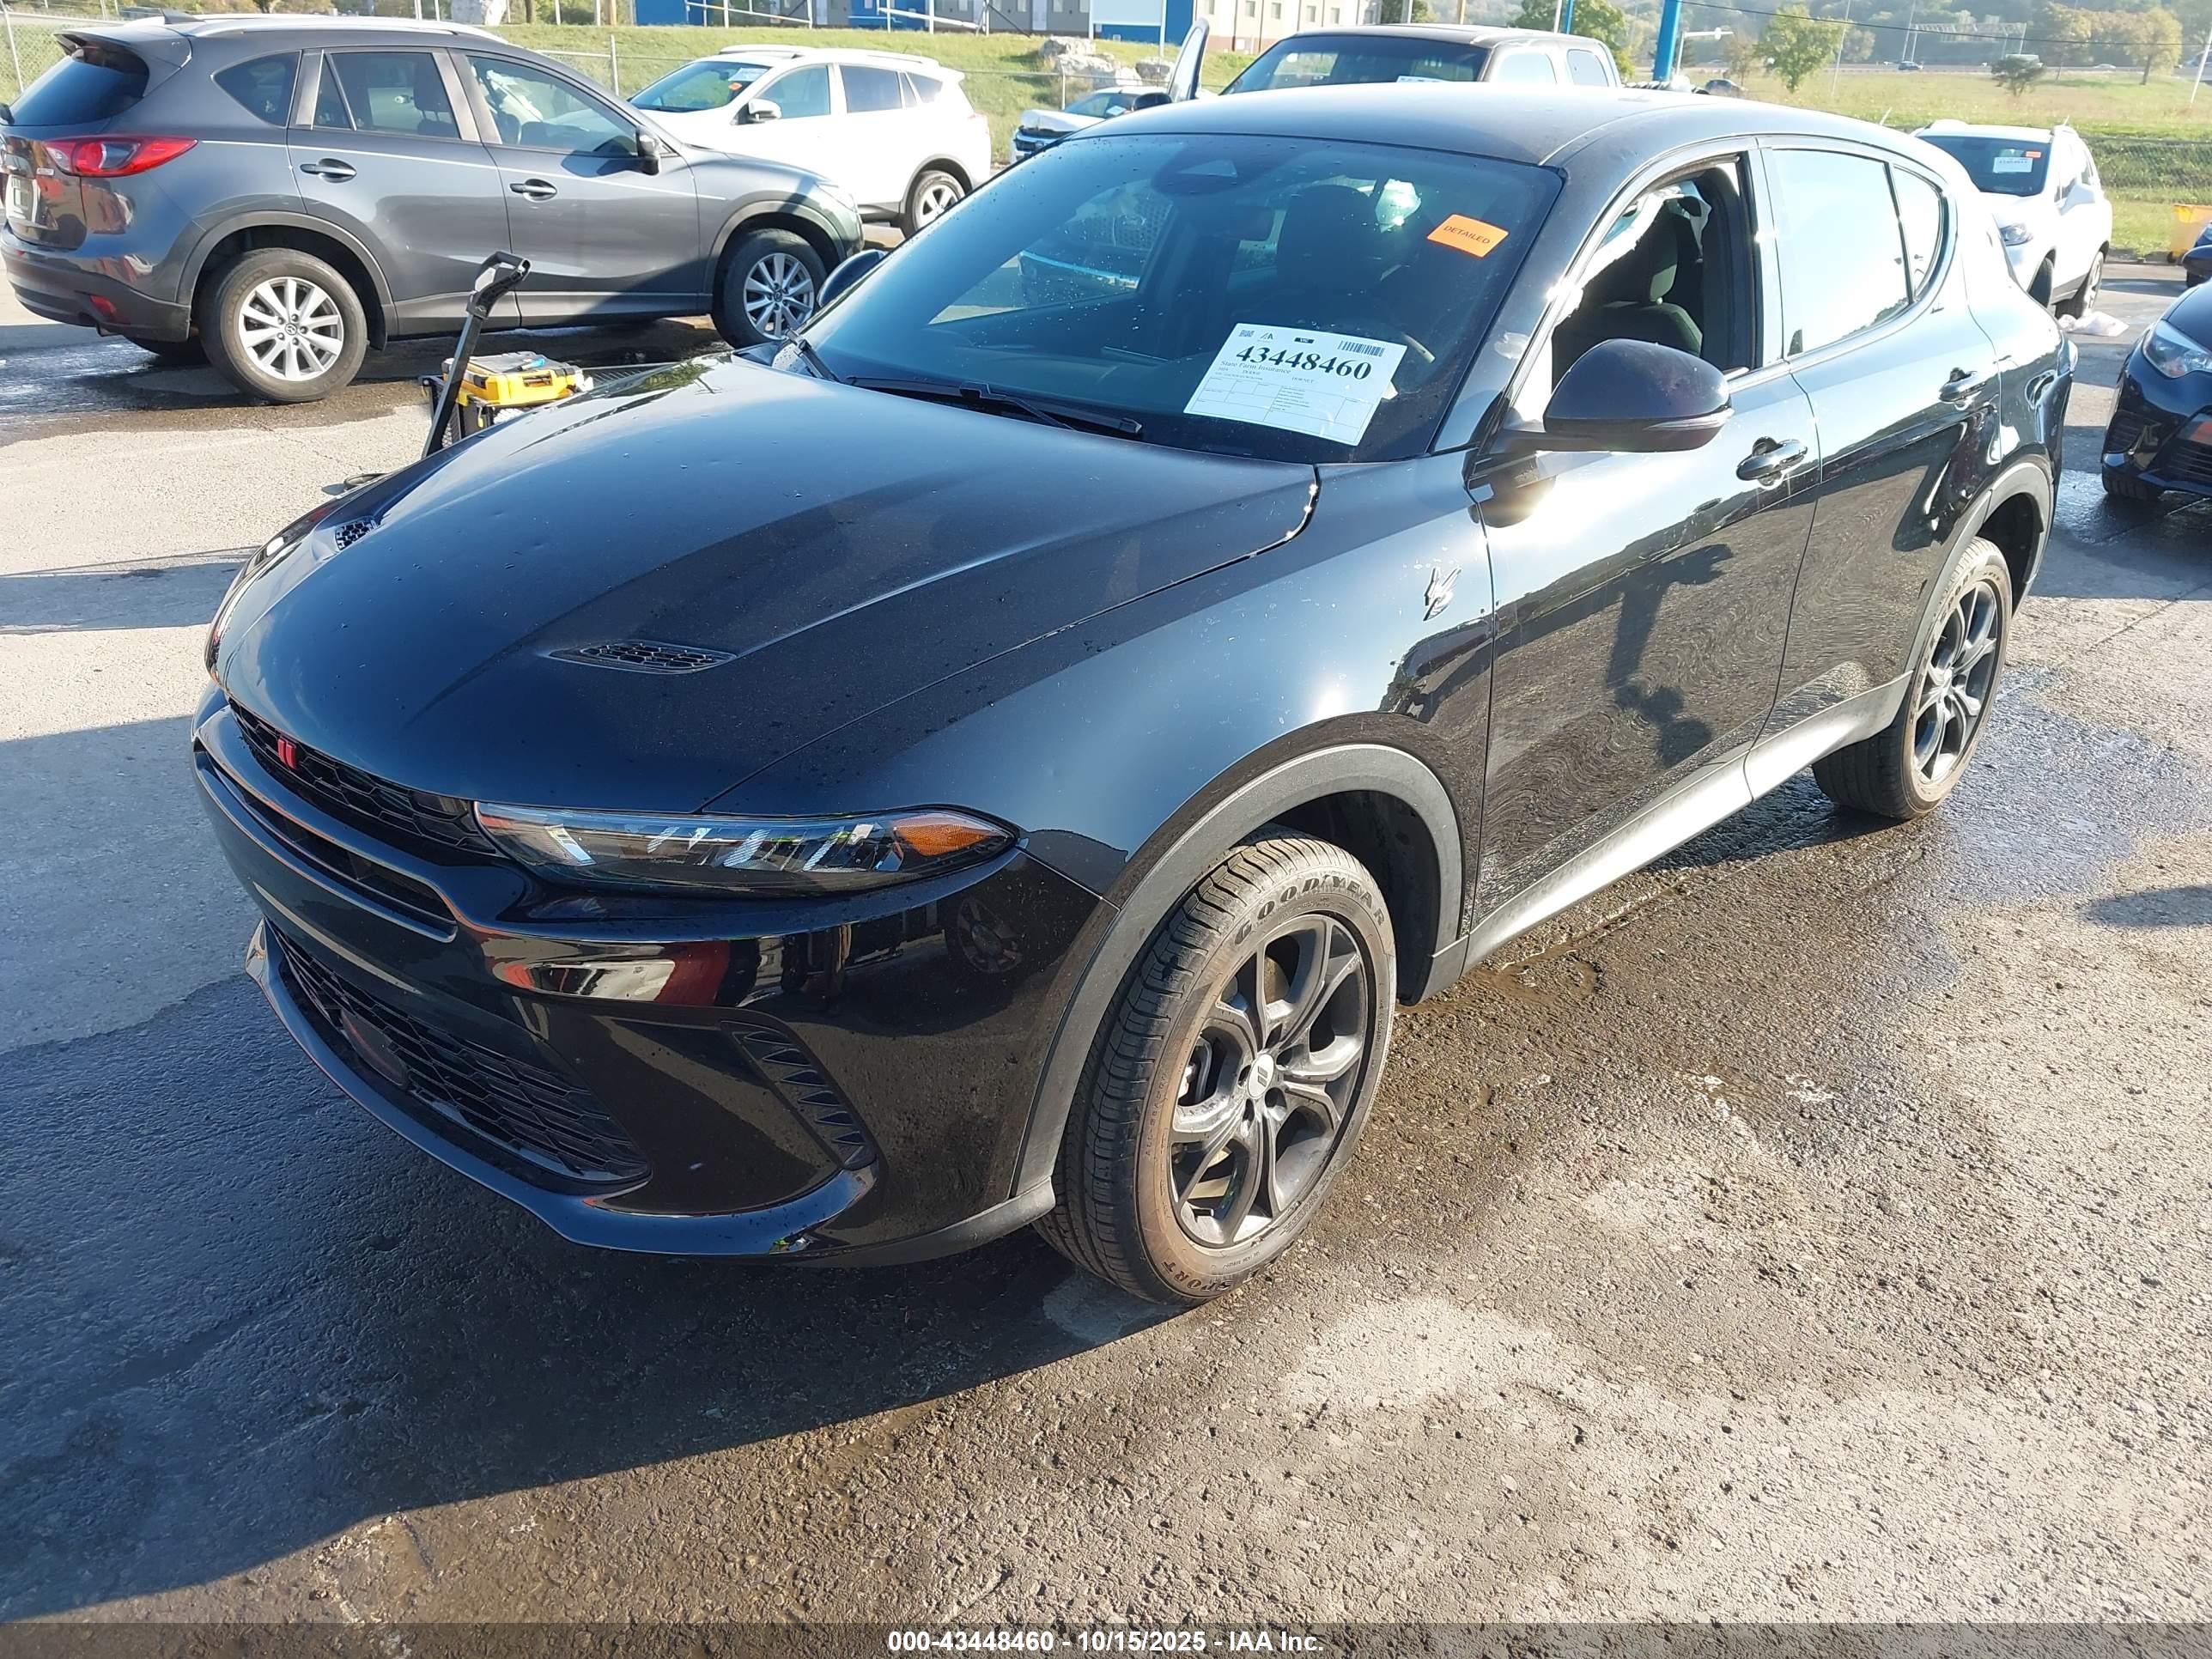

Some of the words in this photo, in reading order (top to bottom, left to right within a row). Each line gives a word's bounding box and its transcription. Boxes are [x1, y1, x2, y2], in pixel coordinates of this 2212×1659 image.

[1443, 225, 1491, 244] DETAILED
[1236, 345, 1372, 380] 43448460
[1238, 362, 1257, 370] Farm
[1234, 873, 1386, 945] GOODYEAR
